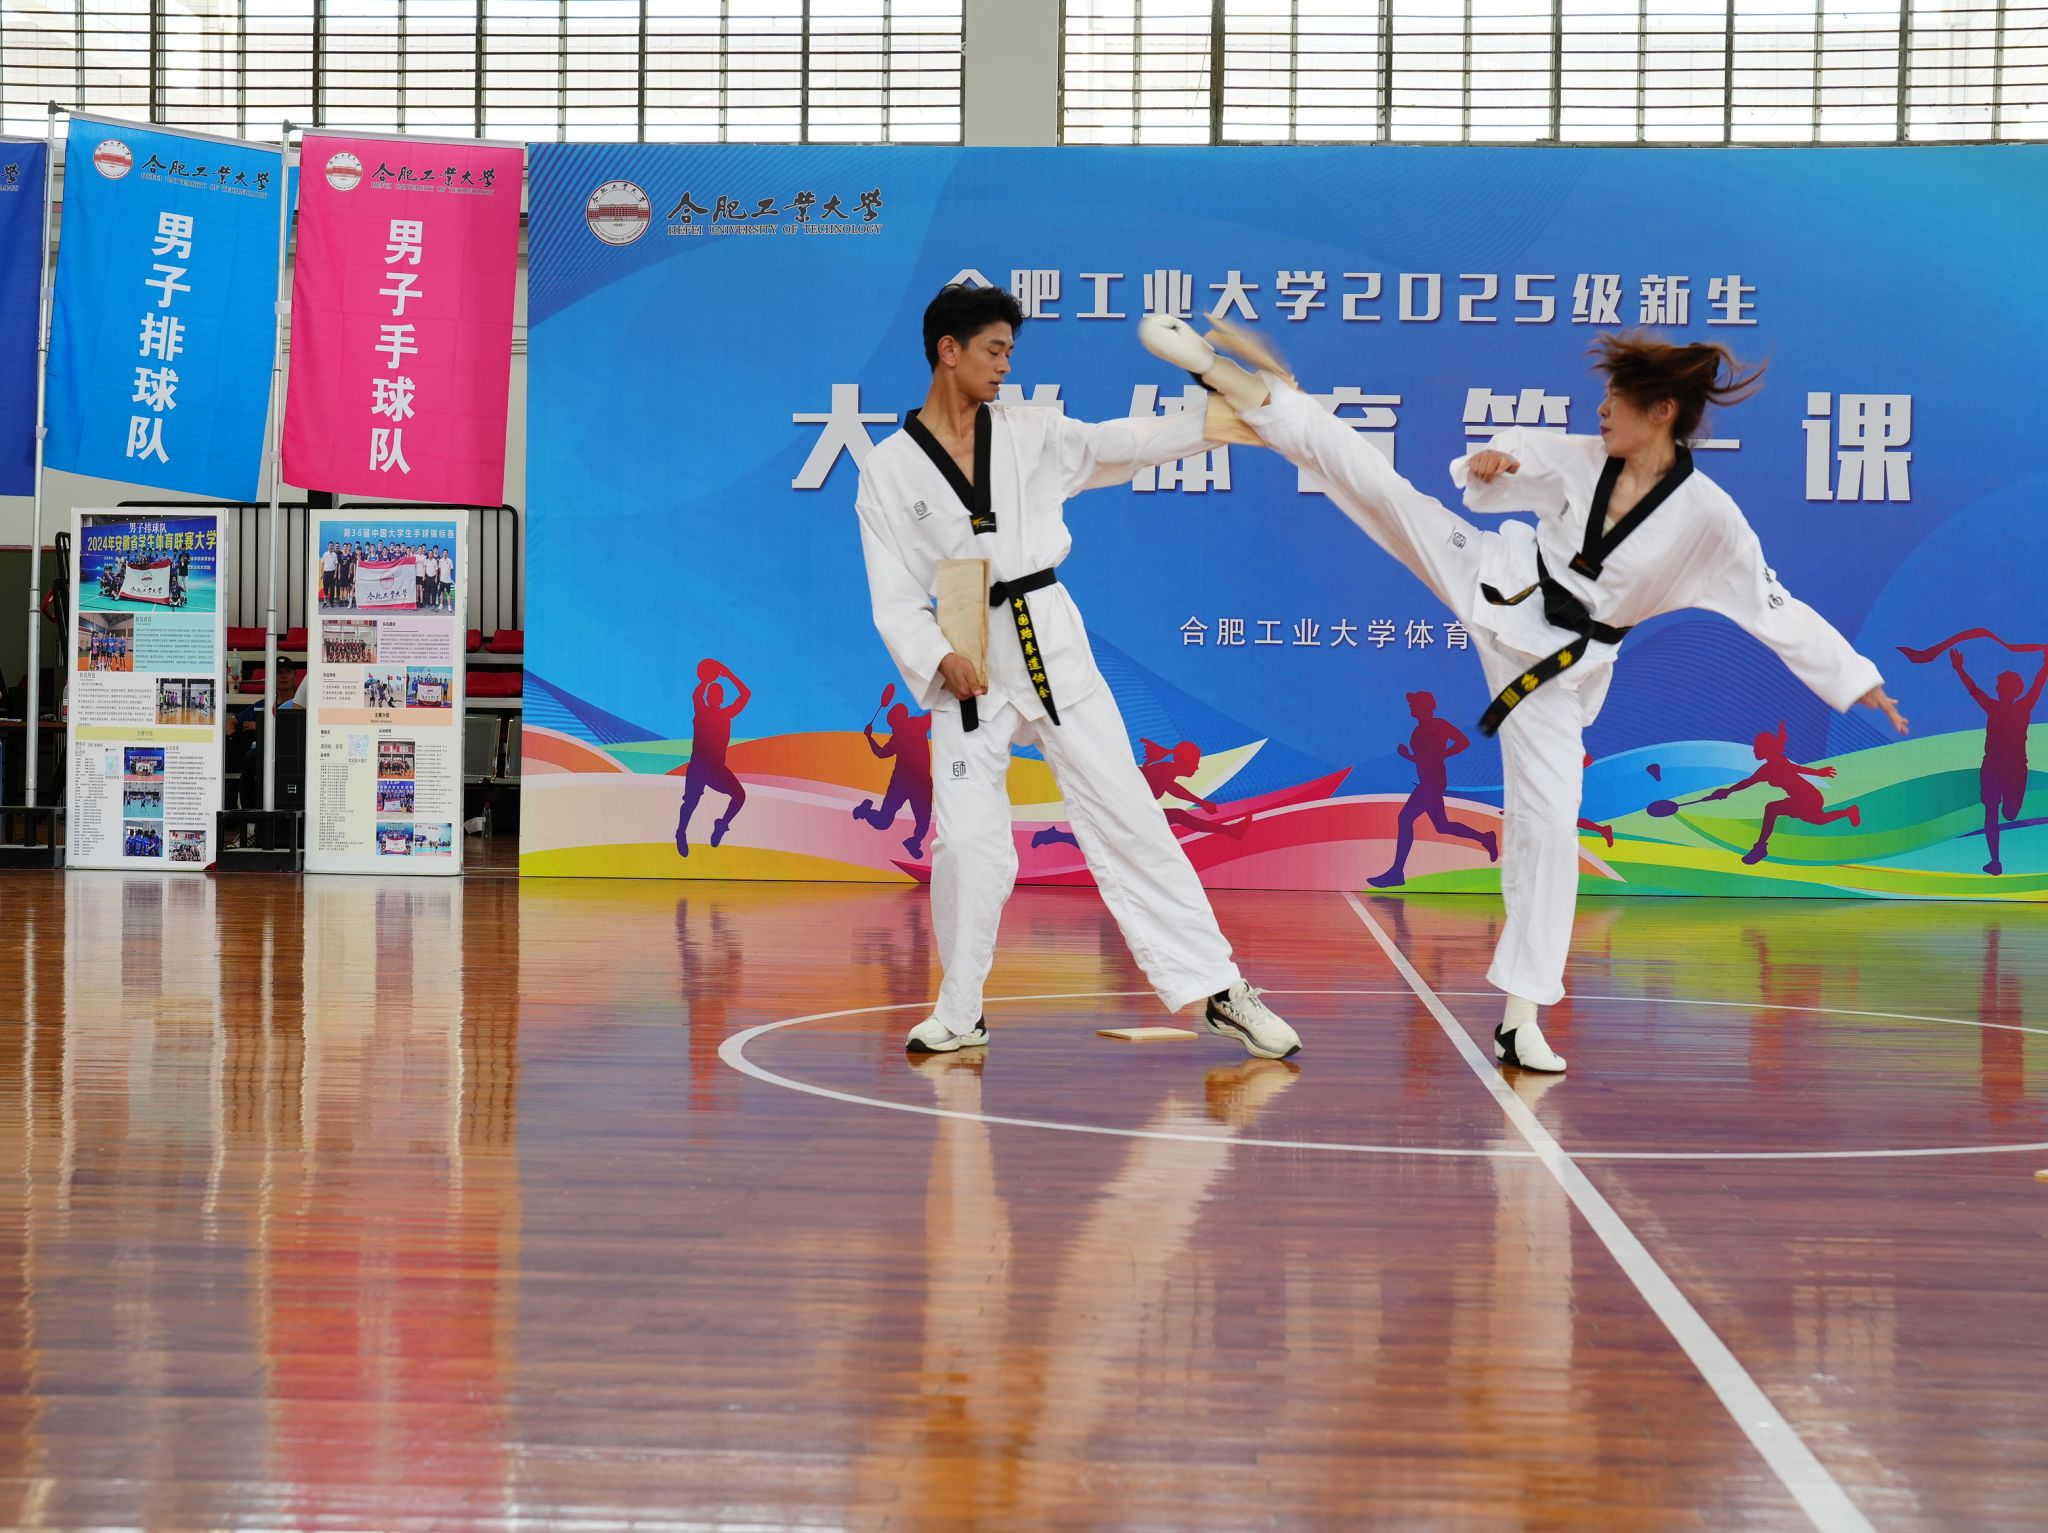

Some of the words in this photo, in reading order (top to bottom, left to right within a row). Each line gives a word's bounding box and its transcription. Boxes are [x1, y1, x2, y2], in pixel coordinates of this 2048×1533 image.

[667, 224, 704, 237] HEFEI
[708, 224, 779, 237] UNIVERSITY
[782, 224, 798, 236] OF
[803, 224, 884, 236] TECHNOLOGY
[125, 211, 194, 466] 男子排球队
[368, 219, 424, 475] 男子手球队
[129, 522, 167, 534] 男子排球队
[1178, 616, 1470, 651] 合肥工业大学体育
